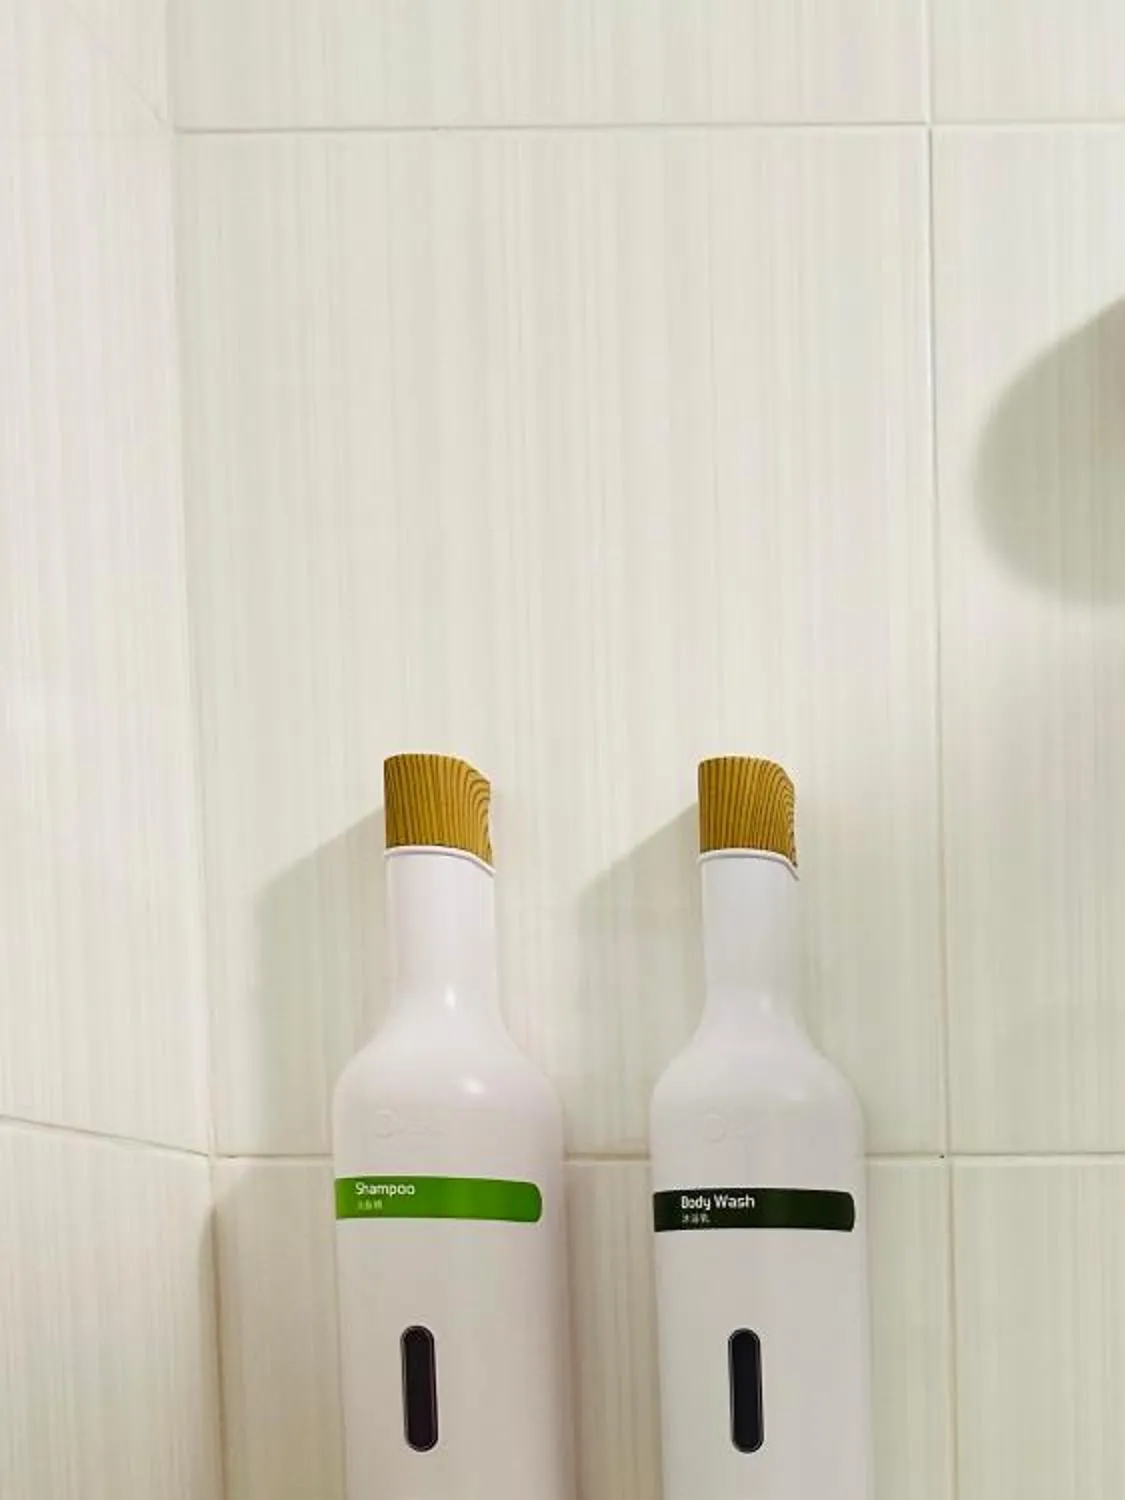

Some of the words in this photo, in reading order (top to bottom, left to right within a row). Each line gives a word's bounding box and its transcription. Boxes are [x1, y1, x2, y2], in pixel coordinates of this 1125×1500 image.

[355, 1182, 415, 1197] Shampoo
[681, 1195, 710, 1210] Body
[713, 1193, 755, 1208] Wash
